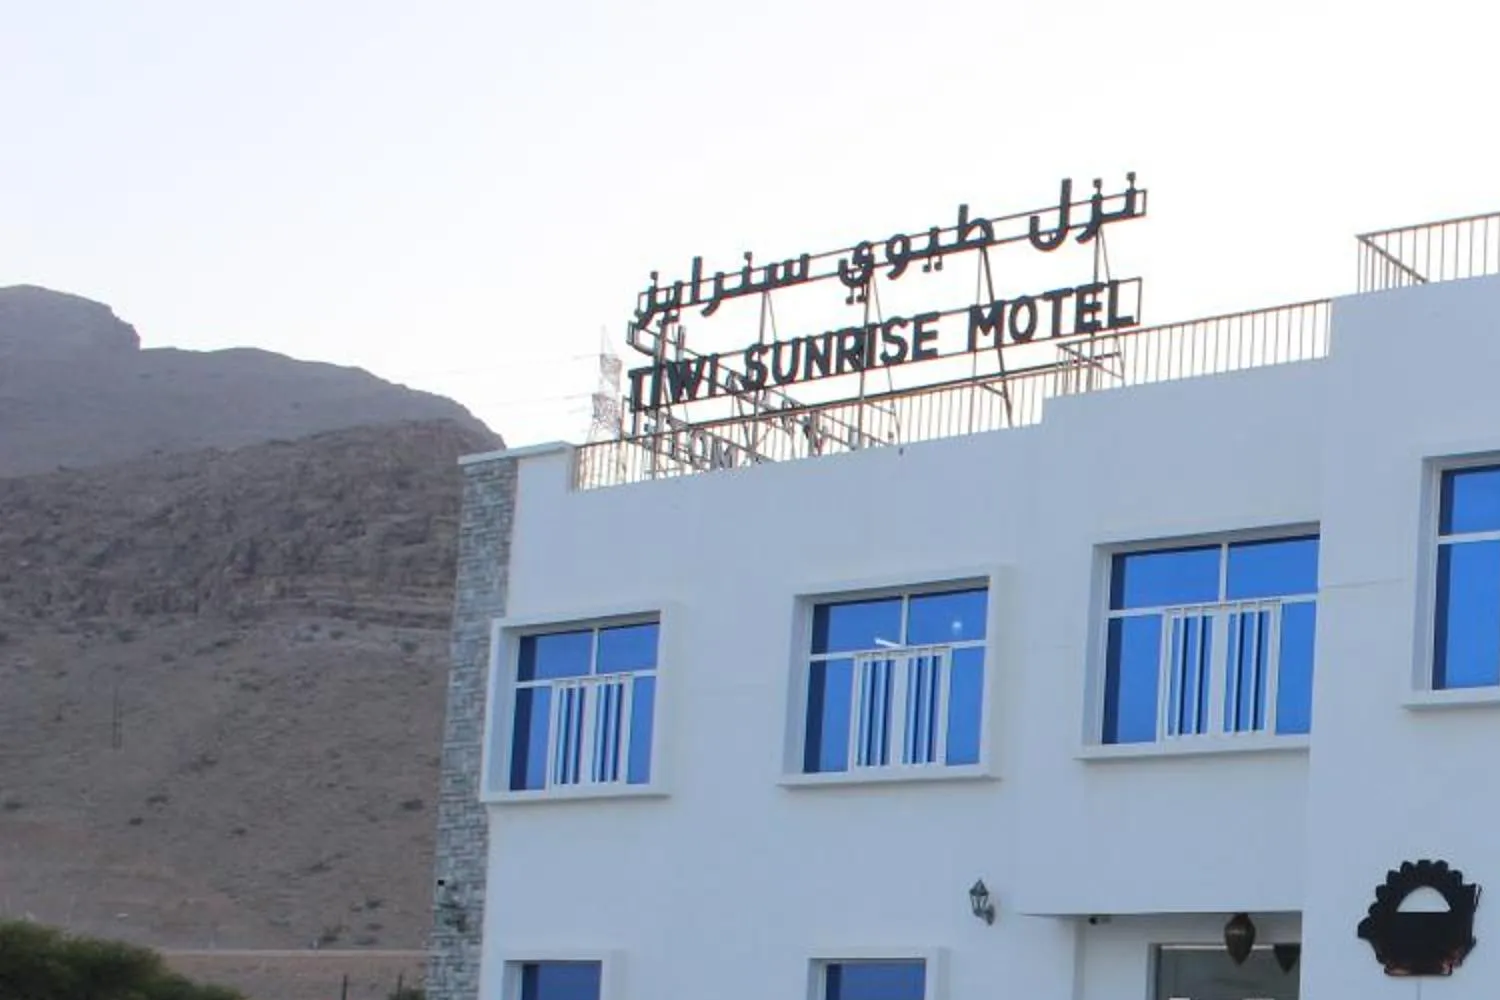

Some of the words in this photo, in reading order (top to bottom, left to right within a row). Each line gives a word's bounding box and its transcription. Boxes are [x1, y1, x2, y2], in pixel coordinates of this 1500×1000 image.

[1030, 172, 1137, 252] نزل
[628, 352, 719, 413] TIWI
[743, 311, 940, 392] SUNRISE
[967, 279, 1135, 353] MOTEL
